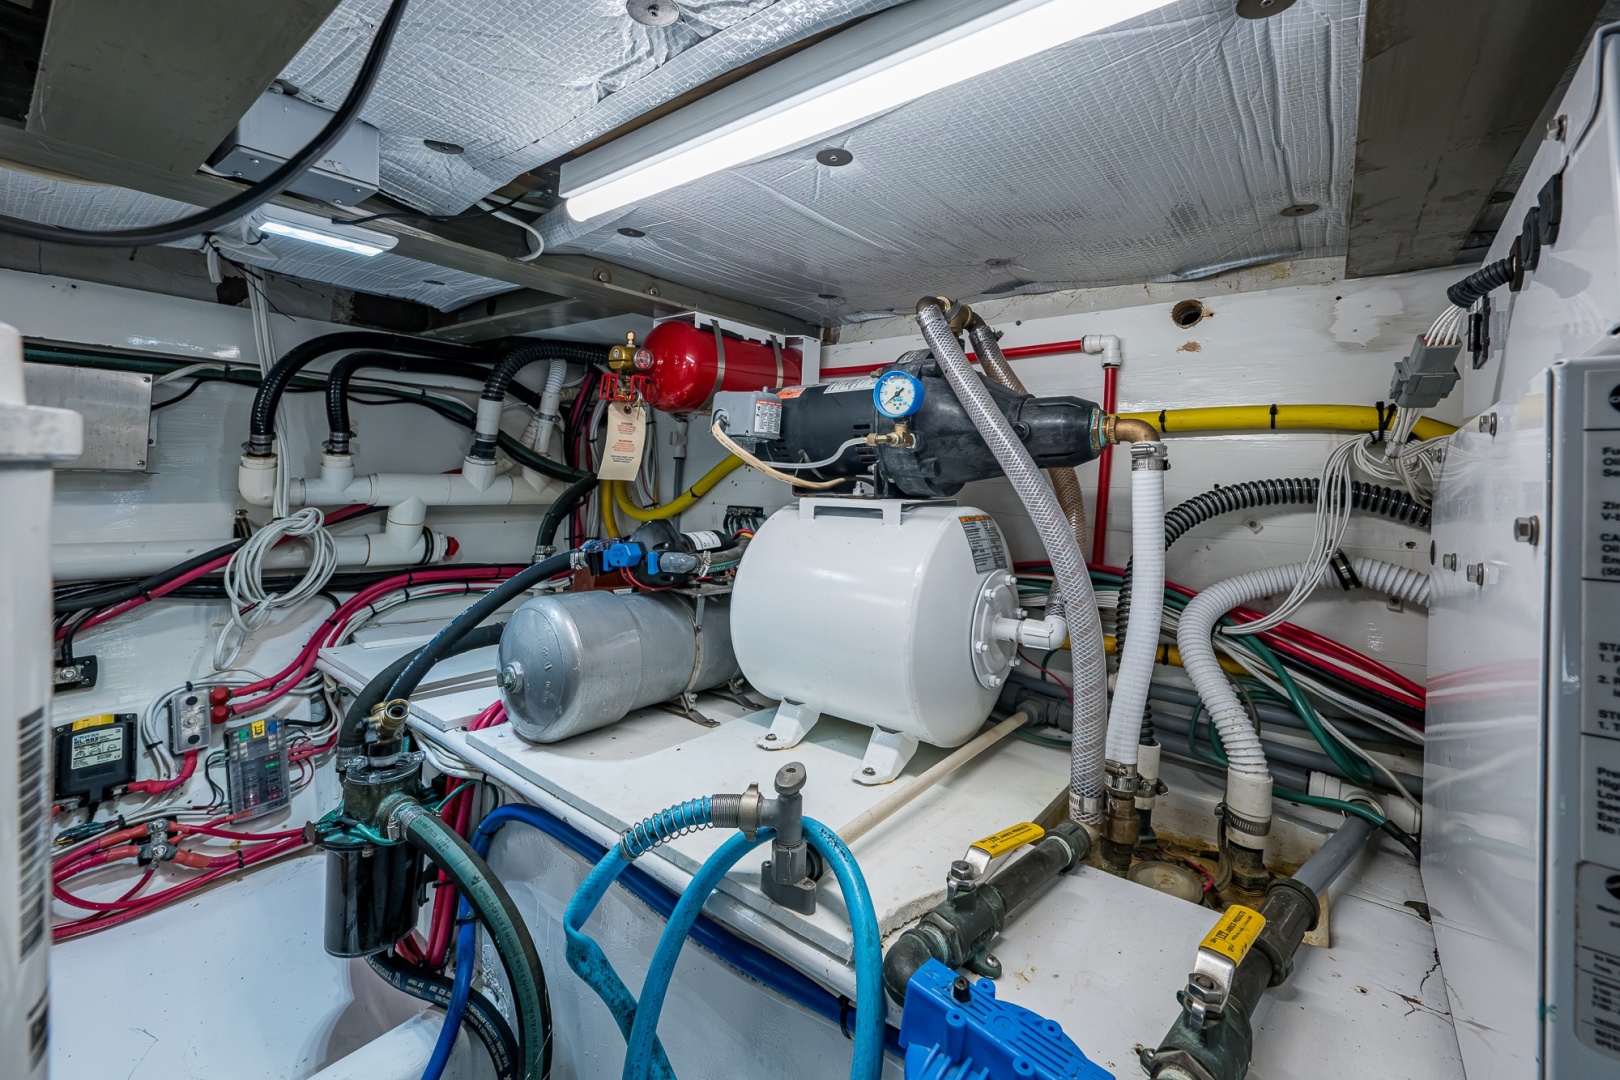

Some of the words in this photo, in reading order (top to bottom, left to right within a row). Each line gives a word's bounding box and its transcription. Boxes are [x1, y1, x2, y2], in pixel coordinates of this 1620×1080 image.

[478, 886, 504, 926] SHIELDSFLEX
[505, 932, 518, 957] MARINE
[515, 958, 524, 974] WET
